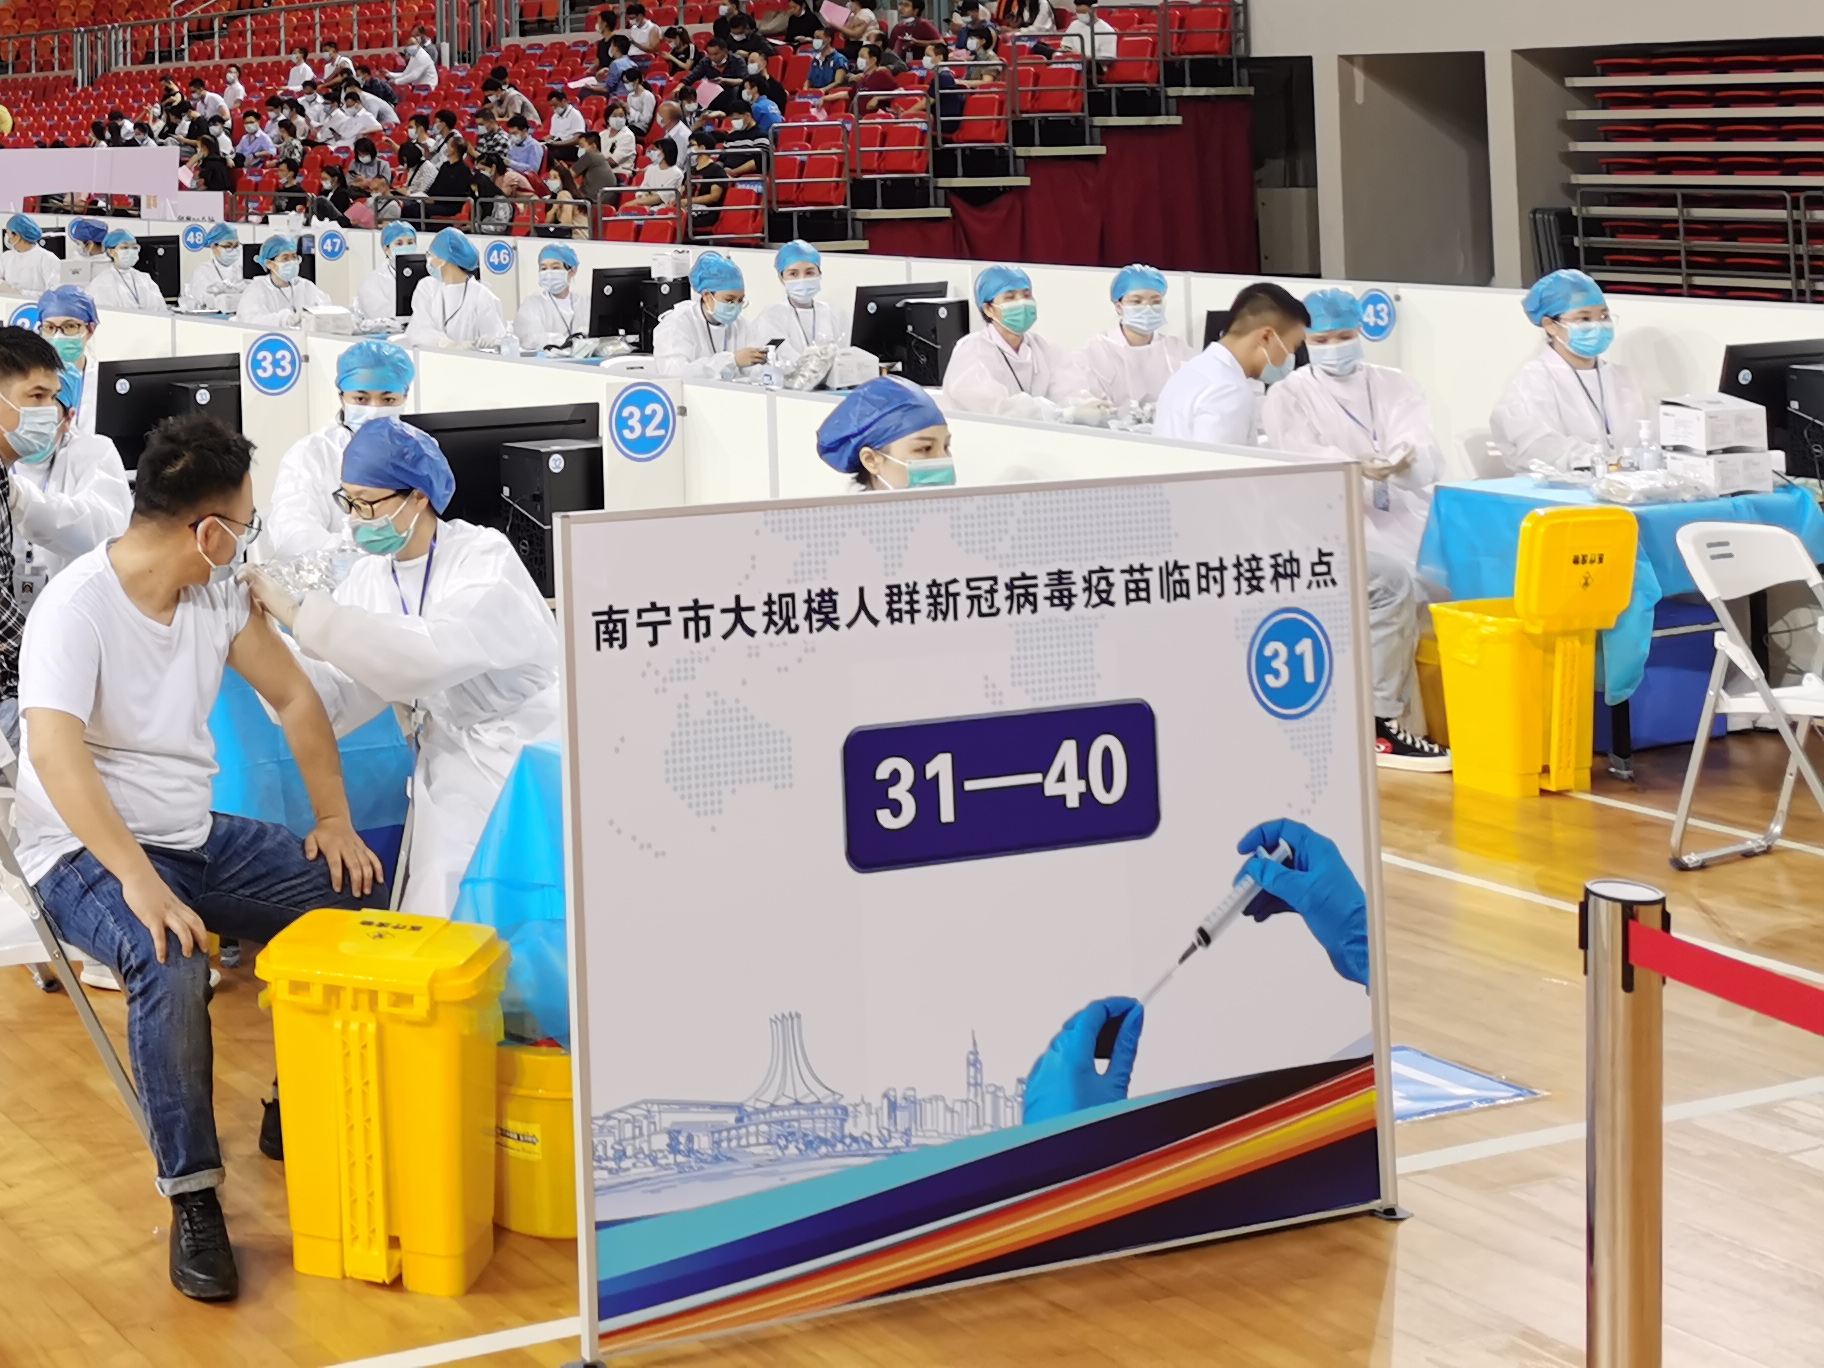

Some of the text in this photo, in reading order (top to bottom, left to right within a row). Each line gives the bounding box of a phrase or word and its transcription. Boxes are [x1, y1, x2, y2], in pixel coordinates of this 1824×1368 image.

[186, 231, 204, 245] 48
[323, 238, 341, 252] 47
[489, 249, 510, 265] 46
[1362, 303, 1389, 327] 43
[256, 350, 293, 378] 33
[621, 403, 666, 440] 32
[591, 548, 1338, 652] 南宁市大规模人群新冠病毒疫苗临时接种点
[1262, 637, 1316, 690] 31
